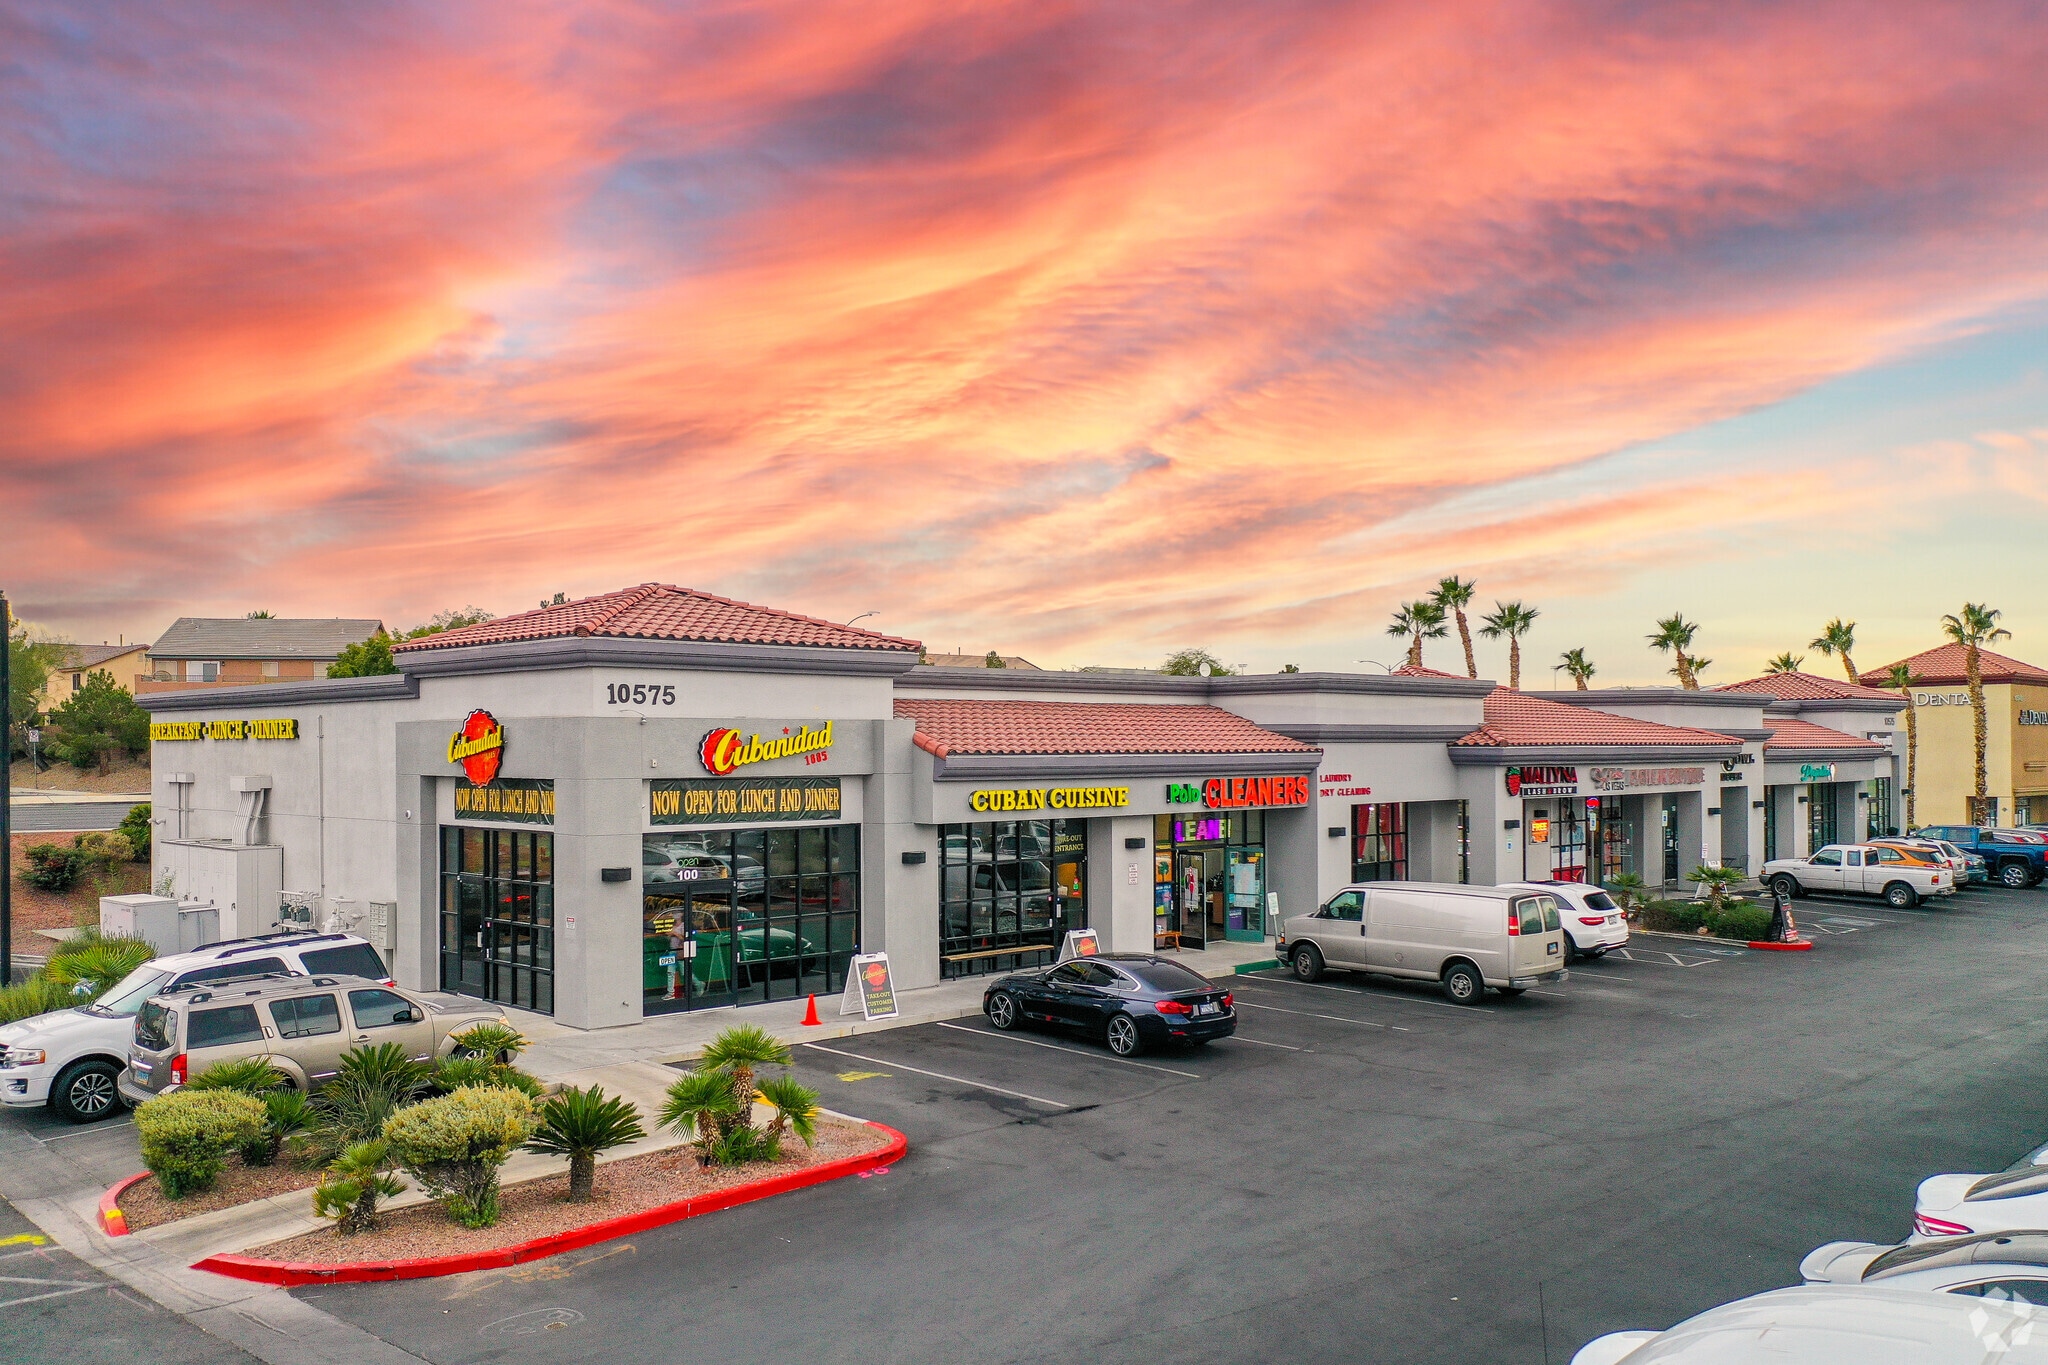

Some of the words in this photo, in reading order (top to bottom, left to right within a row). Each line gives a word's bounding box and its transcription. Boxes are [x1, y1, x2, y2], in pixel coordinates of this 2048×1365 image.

[607, 683, 676, 706] 10575
[1914, 692, 1972, 706] DENTA
[149, 722, 202, 741] BREAKFAST
[208, 720, 245, 740] LUNCH
[251, 719, 296, 739] DINNER
[447, 725, 504, 764] Cubanidad
[713, 720, 834, 772] Cubanidad
[804, 751, 828, 766] 1885
[1320, 774, 1352, 783] LAUNDRY
[971, 788, 1046, 812] CUBAN
[1050, 786, 1130, 809] CUISINE
[1171, 783, 1200, 803] Polo
[1205, 775, 1309, 809] CLEANERS
[1320, 788, 1335, 797] DRY
[1337, 787, 1371, 797] CLEANING
[456, 788, 470, 811] NOW
[472, 788, 487, 812] OPEN
[489, 789, 500, 812] FOR
[502, 790, 523, 813] LUNCH
[525, 790, 538, 814] AND
[652, 791, 680, 816] NOW
[685, 790, 713, 815] OPEN
[717, 789, 737, 814] FOR
[740, 789, 776, 814] LUNCH
[779, 788, 801, 813] AND
[804, 787, 840, 812] DINNER
[1055, 843, 1084, 853] ENTRANCE
[677, 857, 699, 868] open
[677, 869, 698, 881] 100
[660, 956, 675, 965] OPEN
[866, 991, 891, 1000] TAKE-OUT
[867, 999, 893, 1007] CUSTOMER
[870, 1006, 893, 1015] PARKING
